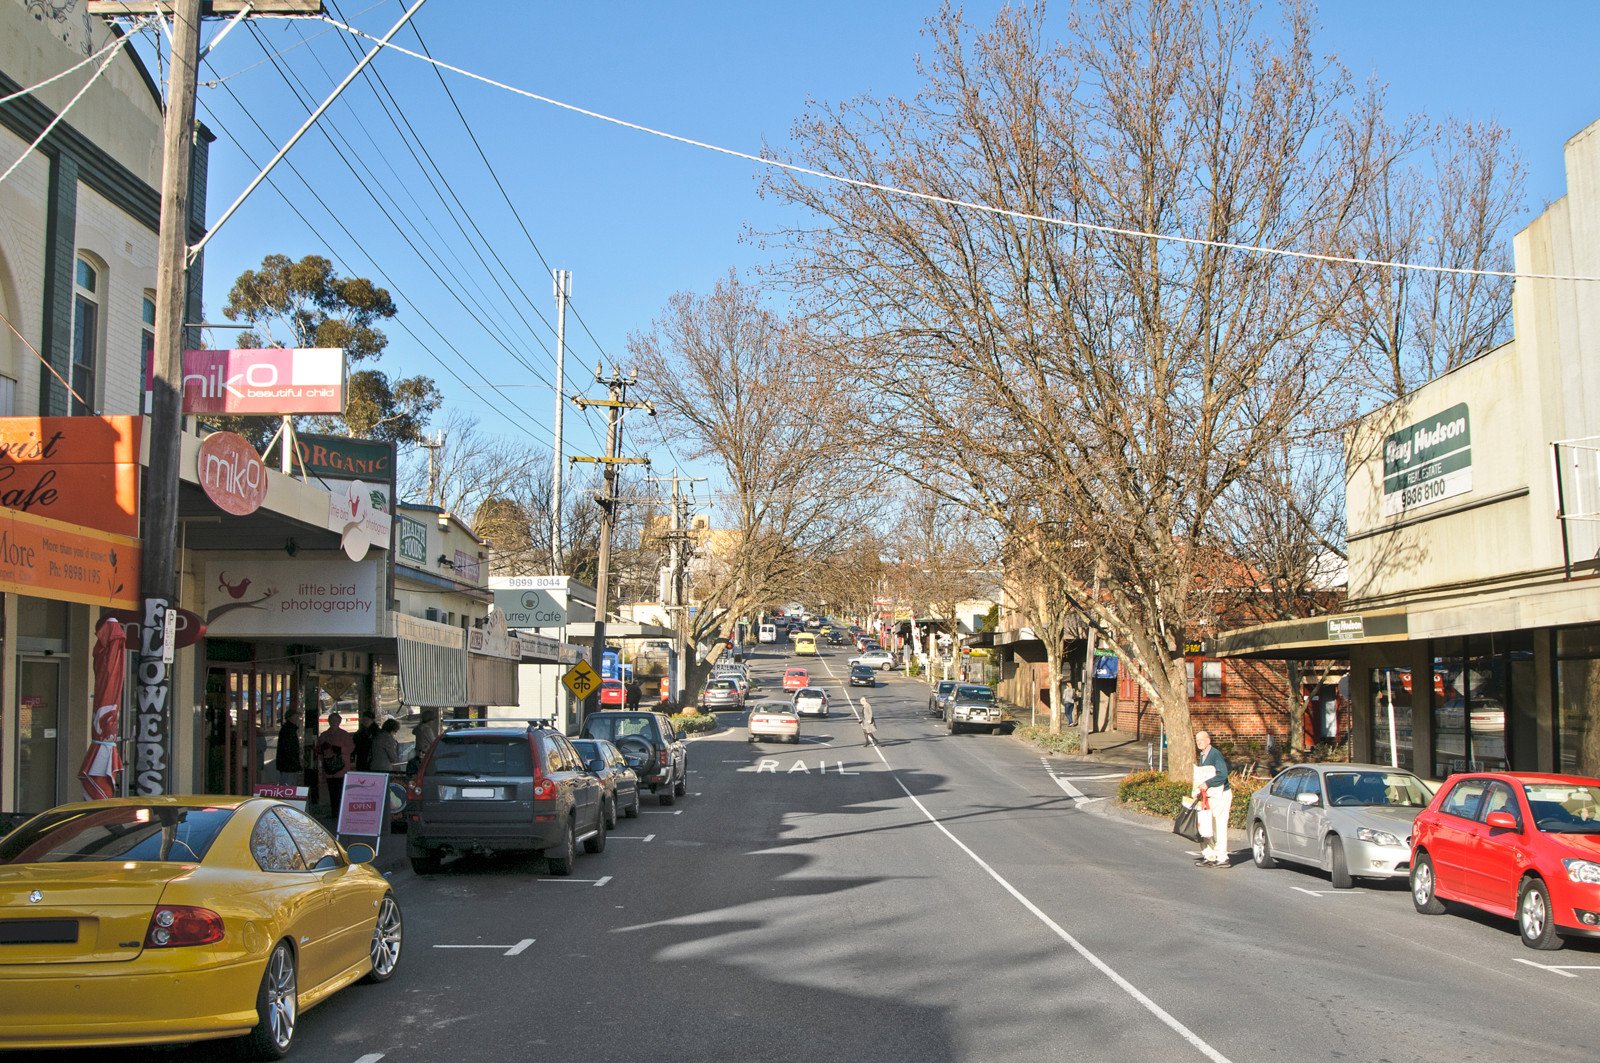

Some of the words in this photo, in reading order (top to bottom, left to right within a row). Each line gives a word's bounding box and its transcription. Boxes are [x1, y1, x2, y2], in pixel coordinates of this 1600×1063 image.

[247, 388, 303, 398] beautiful
[305, 388, 335, 398] child
[1413, 417, 1466, 455] Hudson
[291, 441, 388, 474] ORGANIC
[205, 451, 261, 498] miko
[1421, 462, 1443, 479] ESTATE
[1401, 486, 1423, 508] 9836
[1424, 478, 1446, 500] 8100
[402, 518, 426, 547] HEALTH
[42, 537, 58, 553] More
[404, 537, 423, 560] FOODS
[299, 584, 326, 596] little
[330, 584, 356, 596] bird
[509, 578, 533, 587] 9899
[536, 578, 560, 587] 8044
[281, 599, 372, 613] photography
[505, 612, 531, 623] urrey
[756, 759, 860, 775] RAIL
[259, 787, 294, 798] miko
